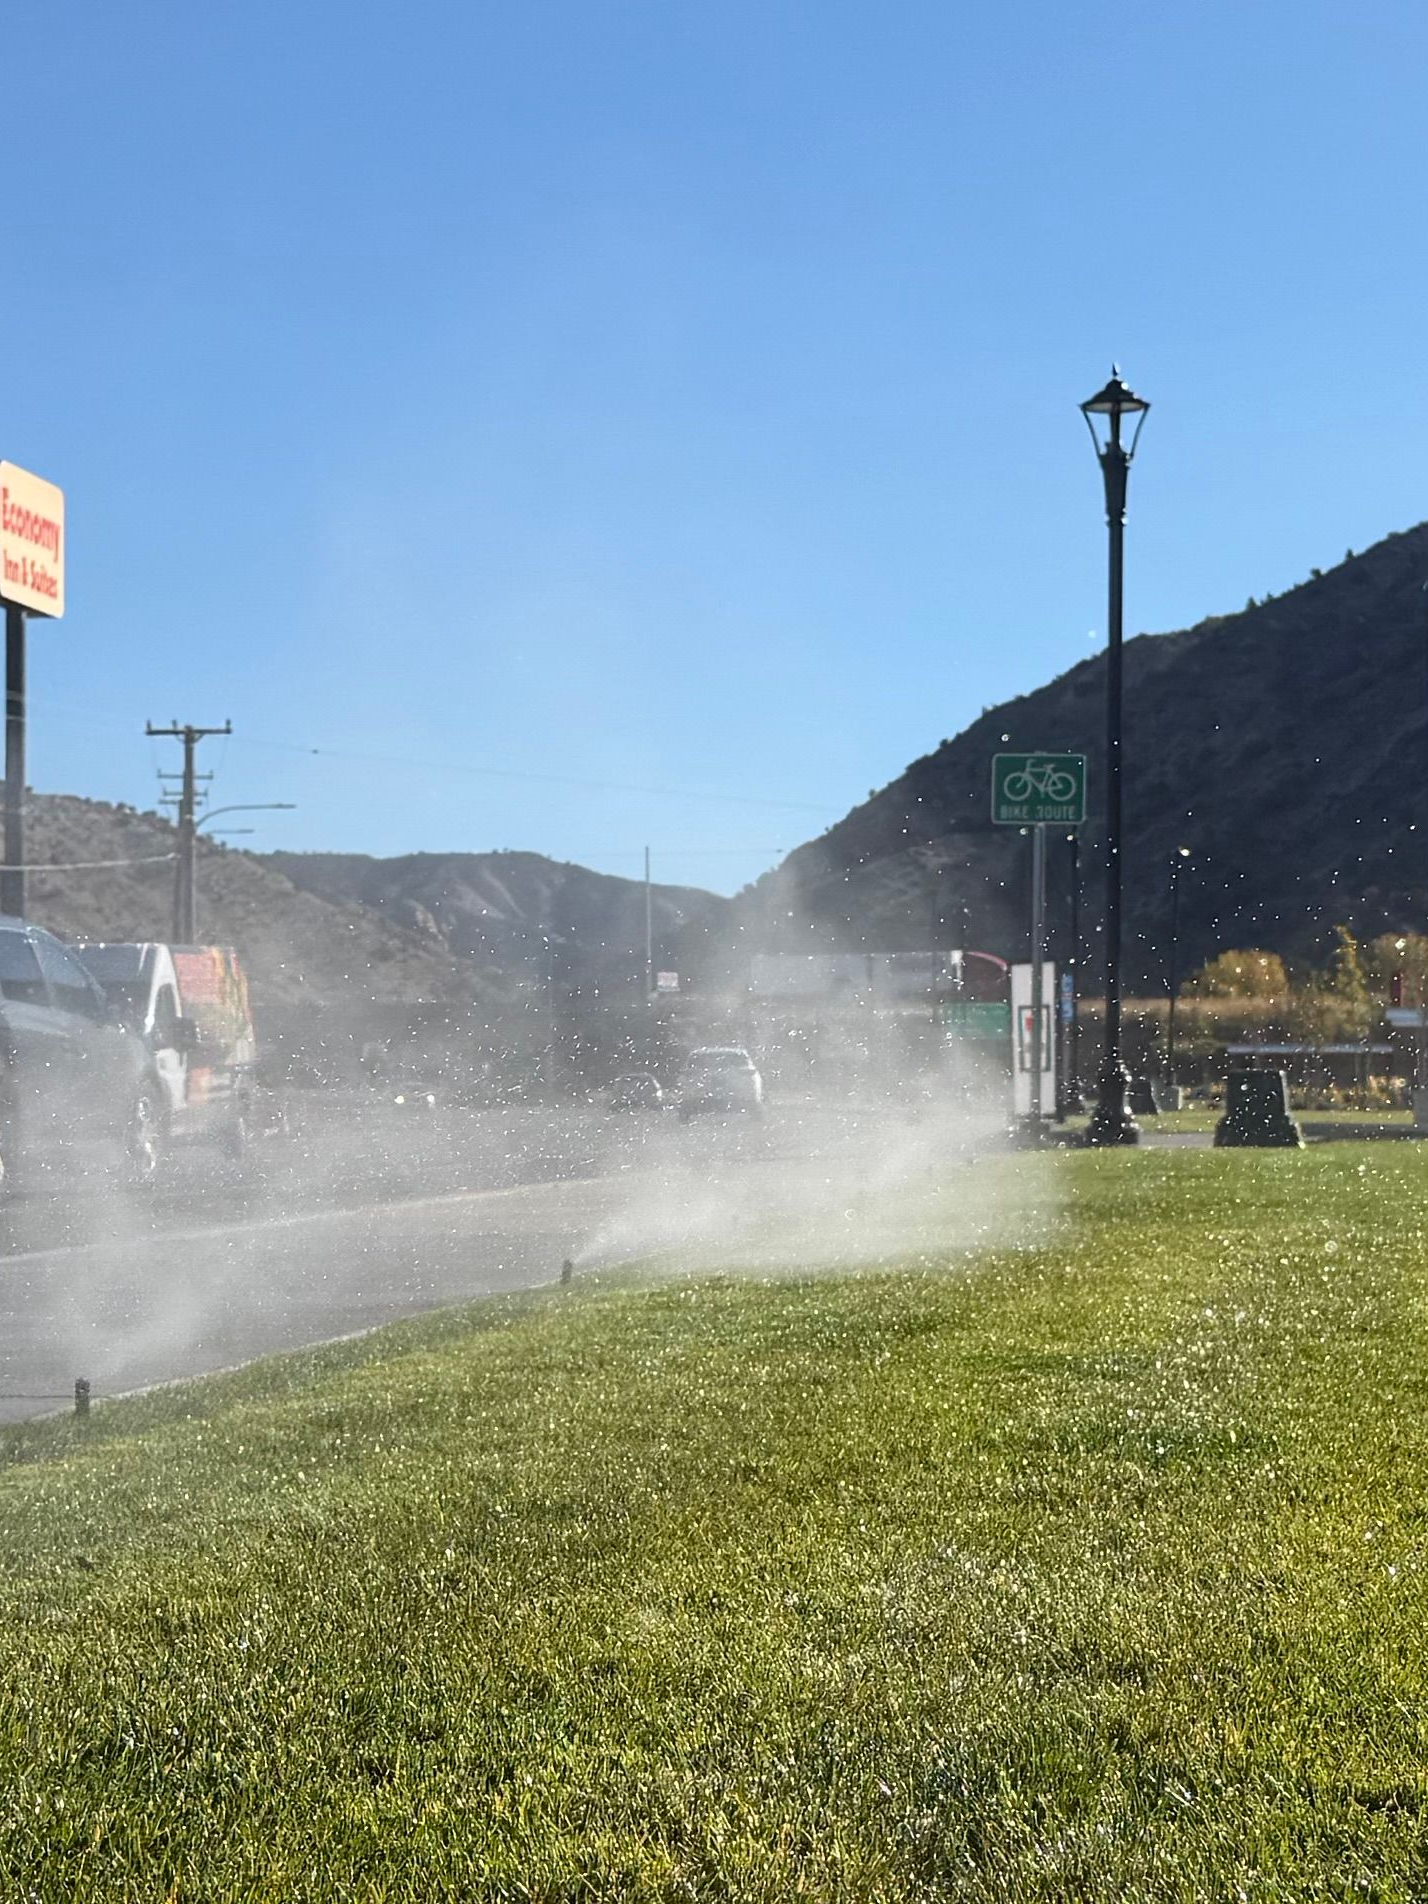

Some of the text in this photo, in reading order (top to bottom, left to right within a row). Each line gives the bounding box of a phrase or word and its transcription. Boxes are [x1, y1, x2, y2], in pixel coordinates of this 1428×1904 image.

[2, 487, 61, 565] Economy
[3, 549, 58, 600] Inn & Suites
[1000, 805, 1029, 819] BIKE
